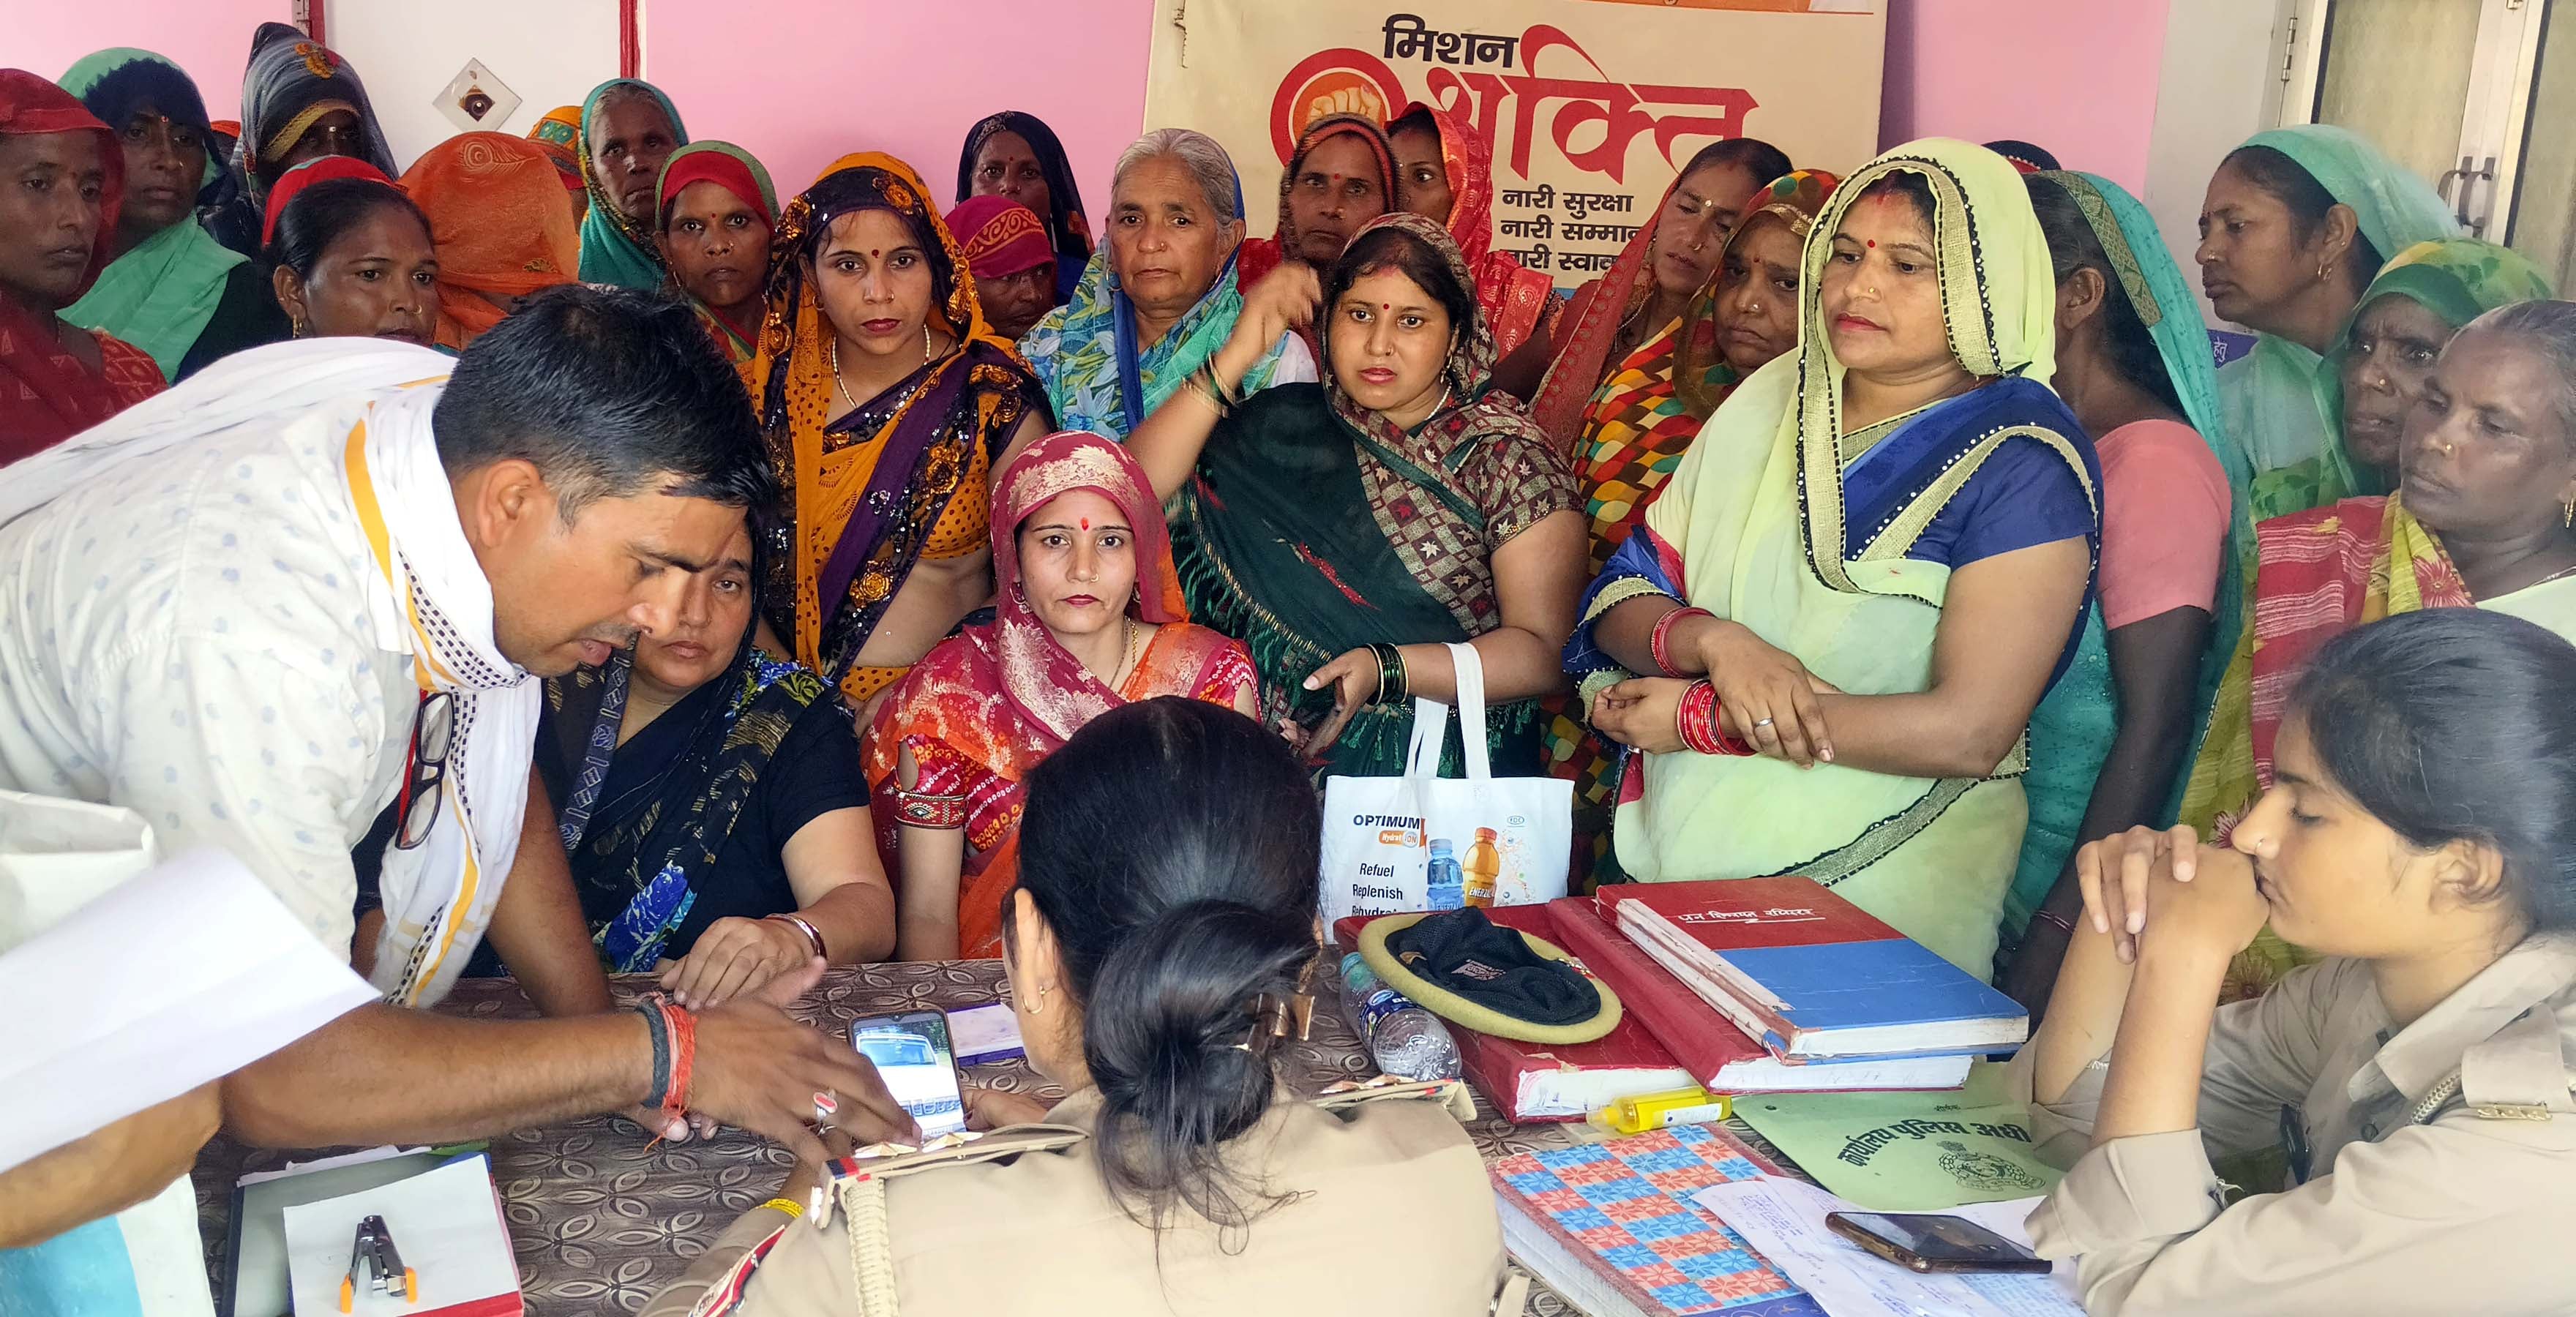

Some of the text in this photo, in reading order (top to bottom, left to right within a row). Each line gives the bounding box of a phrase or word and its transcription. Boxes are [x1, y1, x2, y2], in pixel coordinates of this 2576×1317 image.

[1382, 13, 1519, 68] मिशन
[1426, 24, 1760, 185] शक्ति
[1502, 184, 1634, 220] नारी सुरक्षा
[1500, 214, 1554, 239] नारी
[1353, 814, 1420, 830] OPTIMUM
[1360, 863, 1394, 878] Refuel
[1352, 884, 1404, 901] Replenish
[1837, 1119, 2032, 1168] कार्यालय पुलिस अधी
